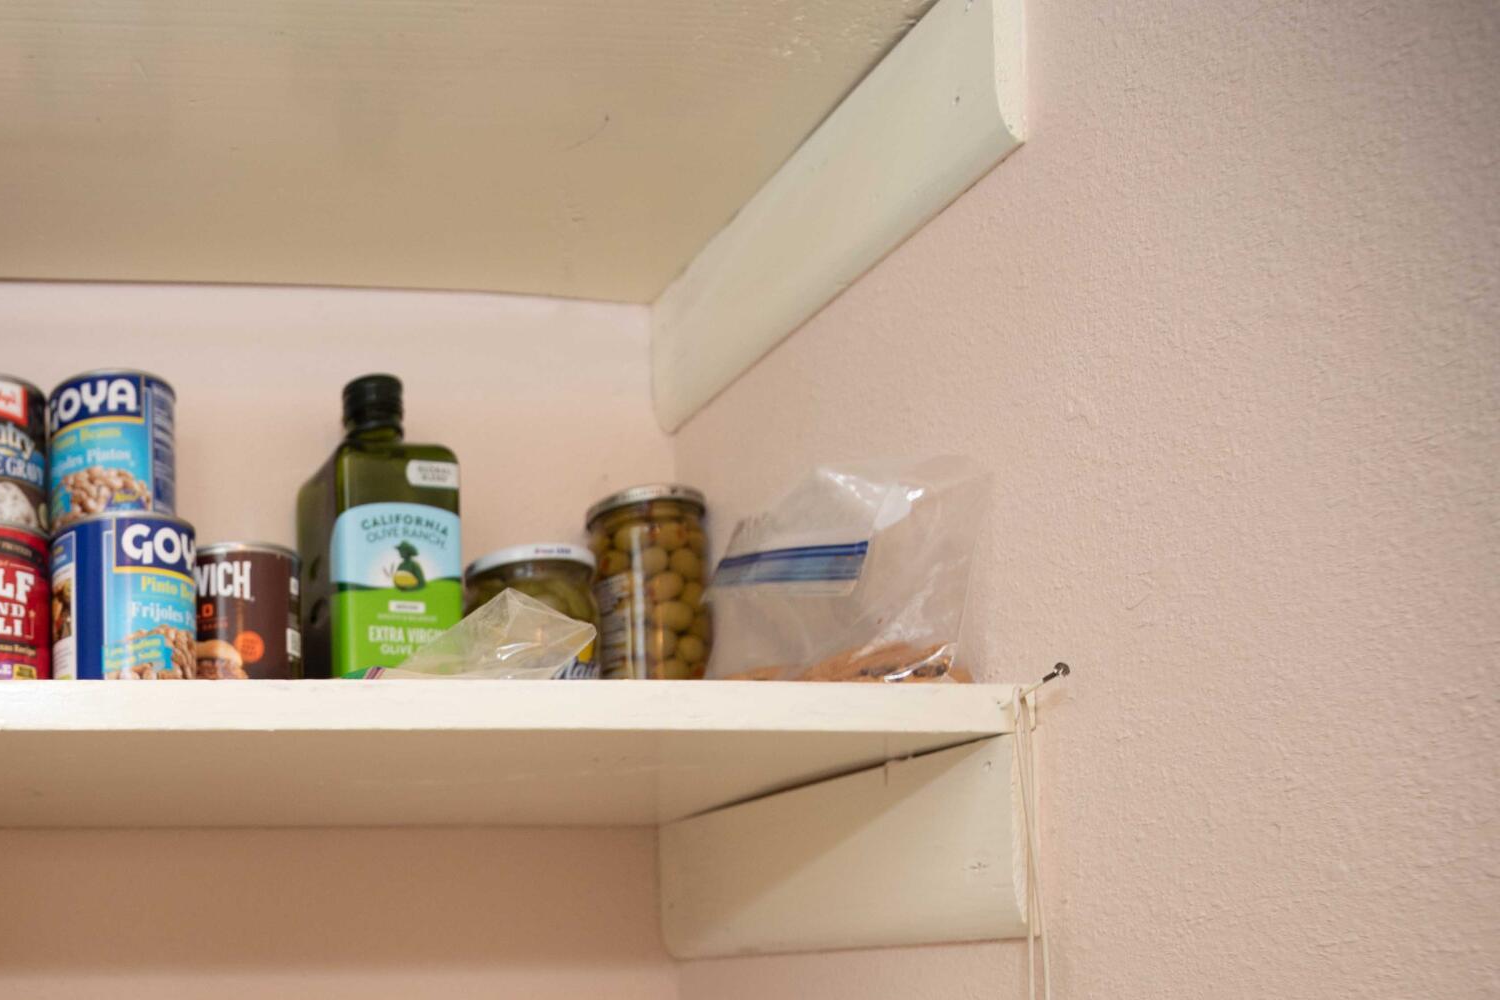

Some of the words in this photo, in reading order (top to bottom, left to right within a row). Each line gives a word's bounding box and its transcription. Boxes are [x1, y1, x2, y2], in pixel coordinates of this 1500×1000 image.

[360, 513, 450, 537] CALIFORNIA
[366, 528, 400, 544] OLIVE
[401, 528, 446, 549] RANCH
[141, 576, 179, 596] Pinto
[131, 602, 184, 623] Frijoles
[368, 625, 405, 643] EXTRA
